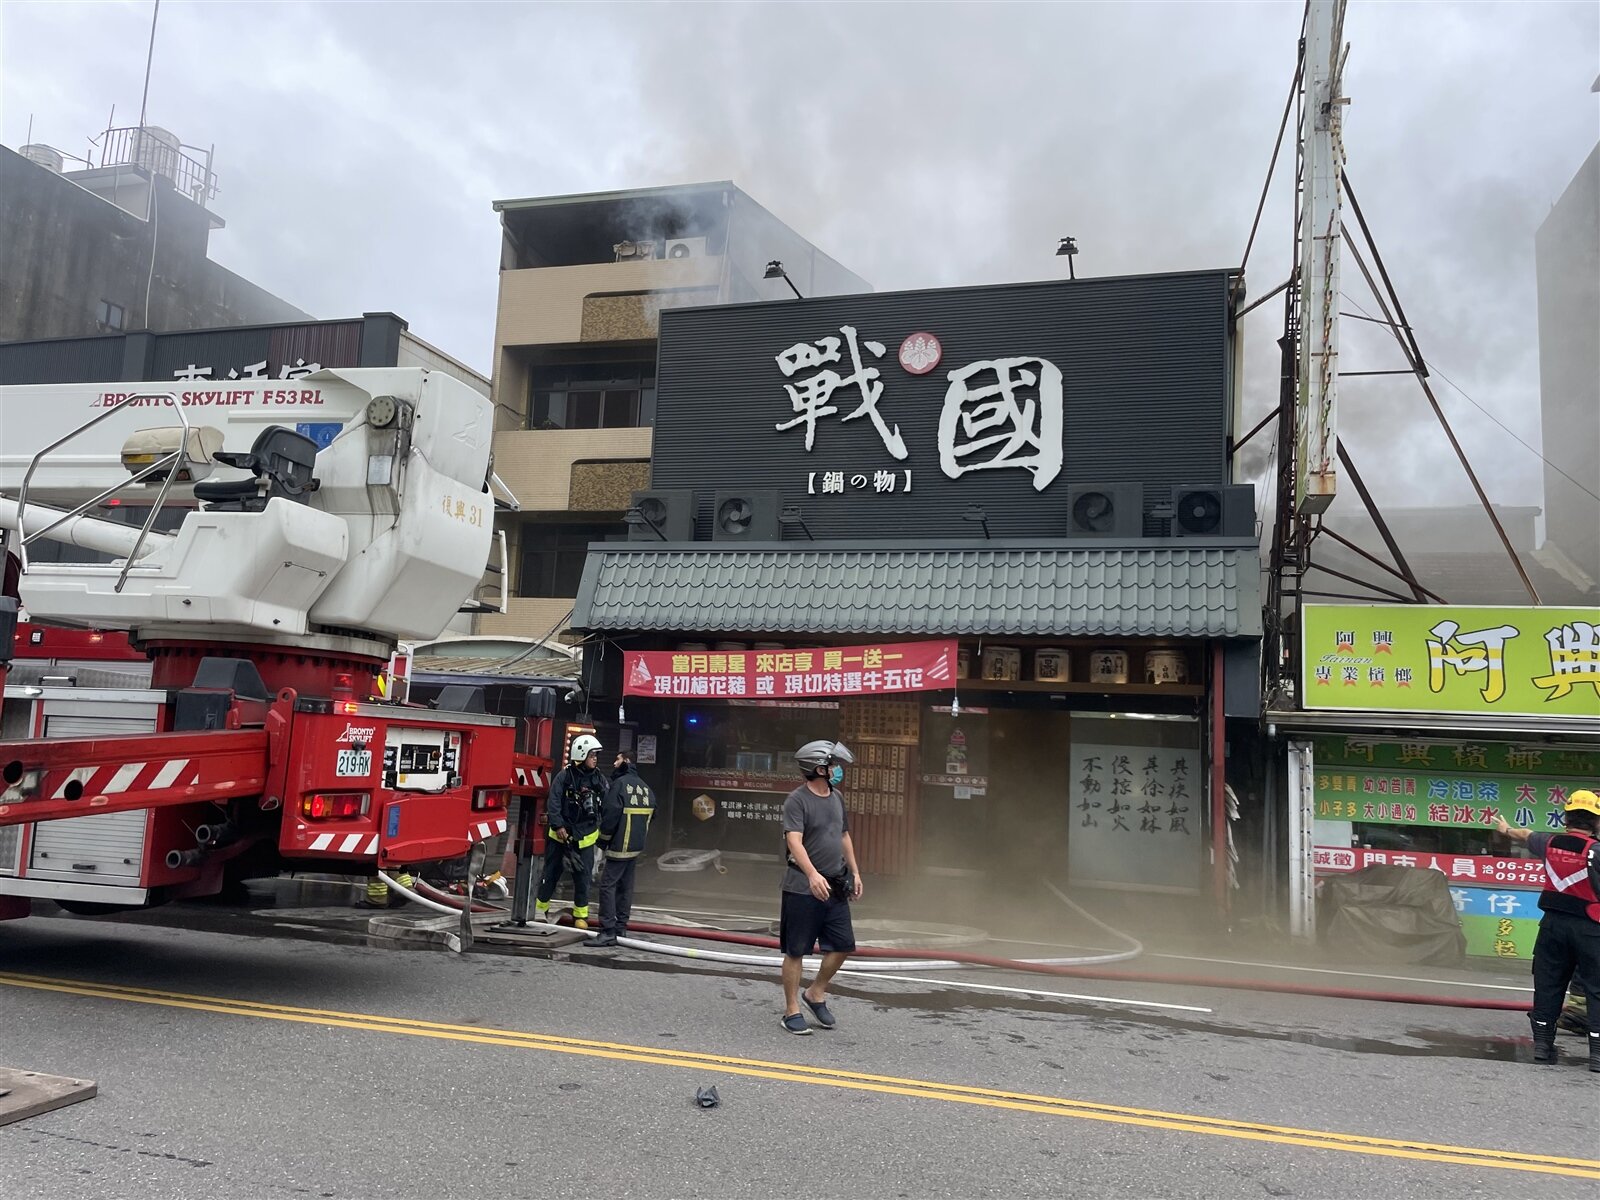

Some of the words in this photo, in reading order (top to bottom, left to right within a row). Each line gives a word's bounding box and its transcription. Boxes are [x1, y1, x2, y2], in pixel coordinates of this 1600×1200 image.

[182, 391, 255, 406] SKYLIFT
[470, 505, 481, 528] 31
[672, 654, 745, 673] 當月壽星
[756, 653, 813, 673] 來店享
[823, 649, 903, 670] 買一送一
[1320, 654, 1372, 664] Tainan
[654, 675, 745, 695] 現切梅花豬
[756, 675, 774, 694] 或
[784, 668, 923, 693] 現切特選牛五花
[1316, 666, 1412, 682] 專業檳榔
[349, 735, 372, 743] SKYLIFT
[1077, 757, 1103, 828] 不動如山
[1428, 779, 1499, 801] 冷泡茶
[1428, 803, 1499, 825] 結冰水
[1313, 851, 1352, 866] 誠徵
